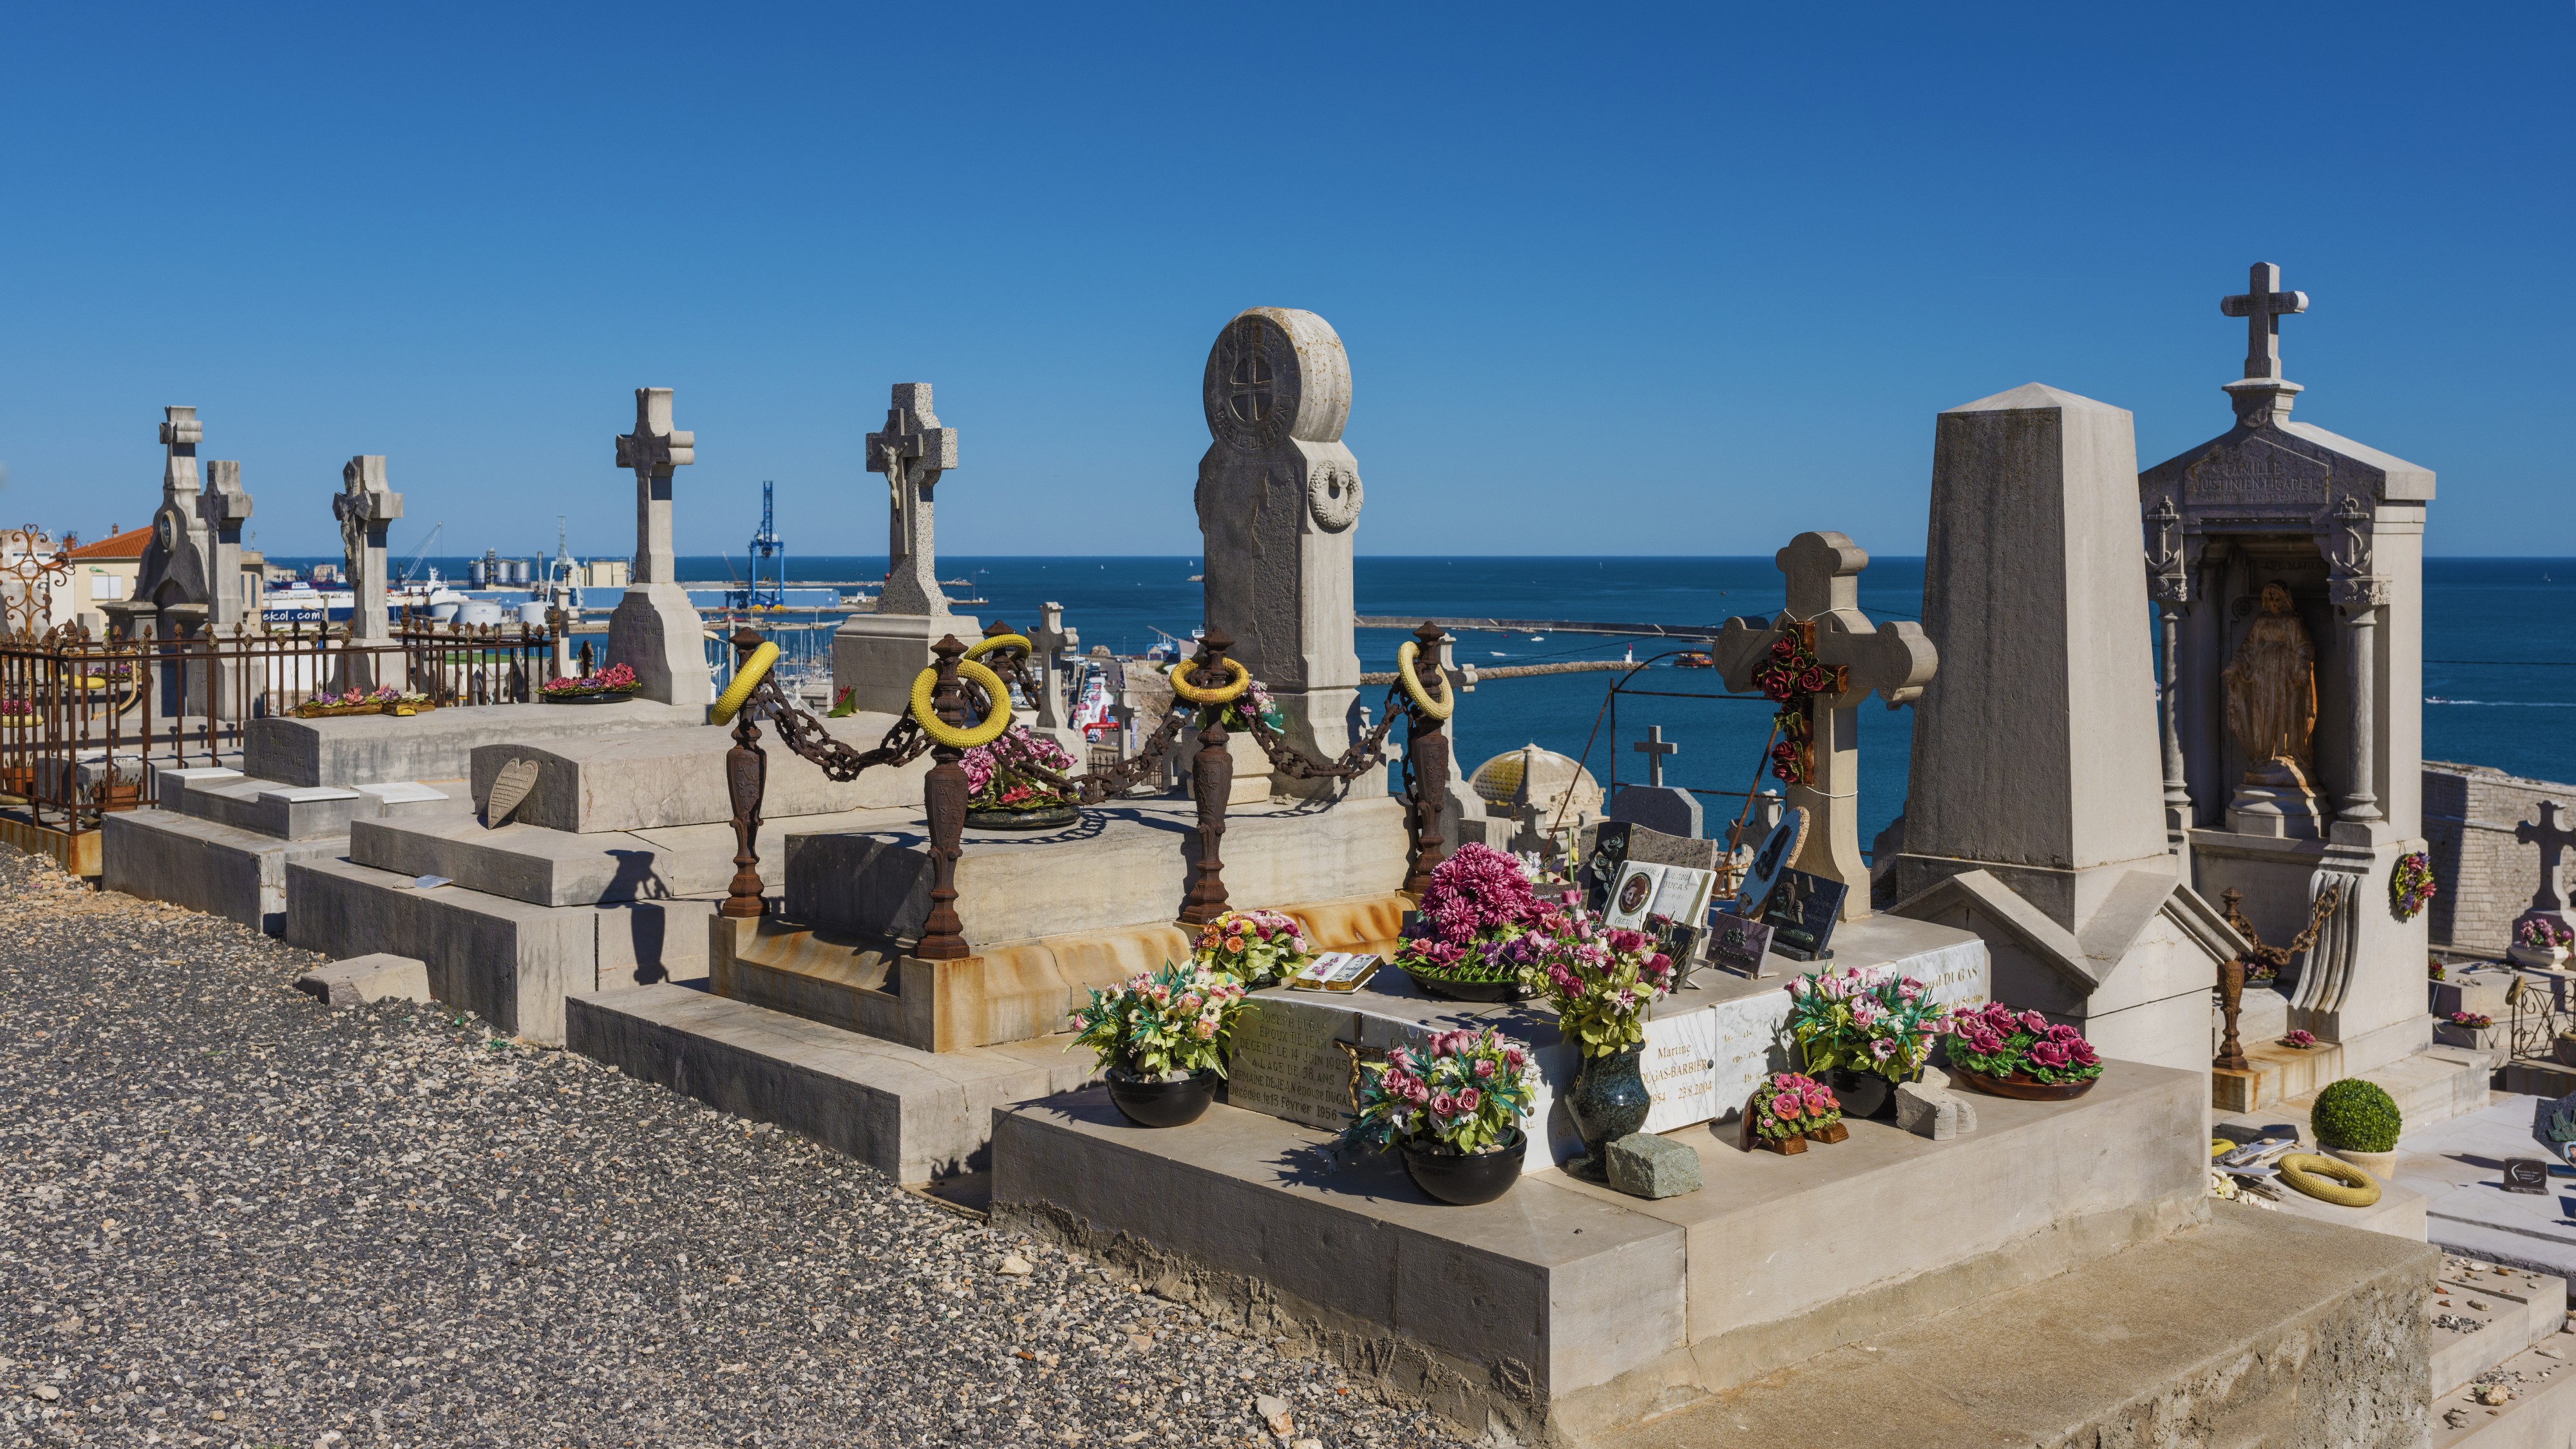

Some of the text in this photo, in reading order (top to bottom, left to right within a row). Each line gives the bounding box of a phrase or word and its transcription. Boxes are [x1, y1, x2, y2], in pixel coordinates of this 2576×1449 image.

[1224, 327, 1278, 359] FAMILLE
[1214, 406, 1289, 450] BREIL-DALBIN
[2226, 461, 2282, 475] FAMILLE
[2194, 477, 2260, 492] JUSTINIEN
[1662, 880, 1689, 891] DUGAS
[1260, 1010, 1327, 1036] JOSEPH DUGAS
[1291, 1032, 1327, 1051] DEJEAN
[1658, 1043, 1690, 1060] Martine
[1252, 1058, 1335, 1085] A L'AGE DE 38 ANS
[1276, 1046, 1287, 1058] LE
[1291, 1048, 1299, 1061] 14
[1303, 1051, 1323, 1066] JUIN
[1326, 1057, 1348, 1072] 1925
[1641, 1059, 1707, 1083] DUGAS-BARBIER
[1229, 1066, 1264, 1087] GERMAINE
[1265, 1075, 1296, 1094] DEJEAN
[1297, 1081, 1325, 1101] épouse
[1678, 1081, 1712, 1099] 23.8.2004
[1229, 1083, 1261, 1102] Décédée
[1317, 1104, 1337, 1121] 1956
